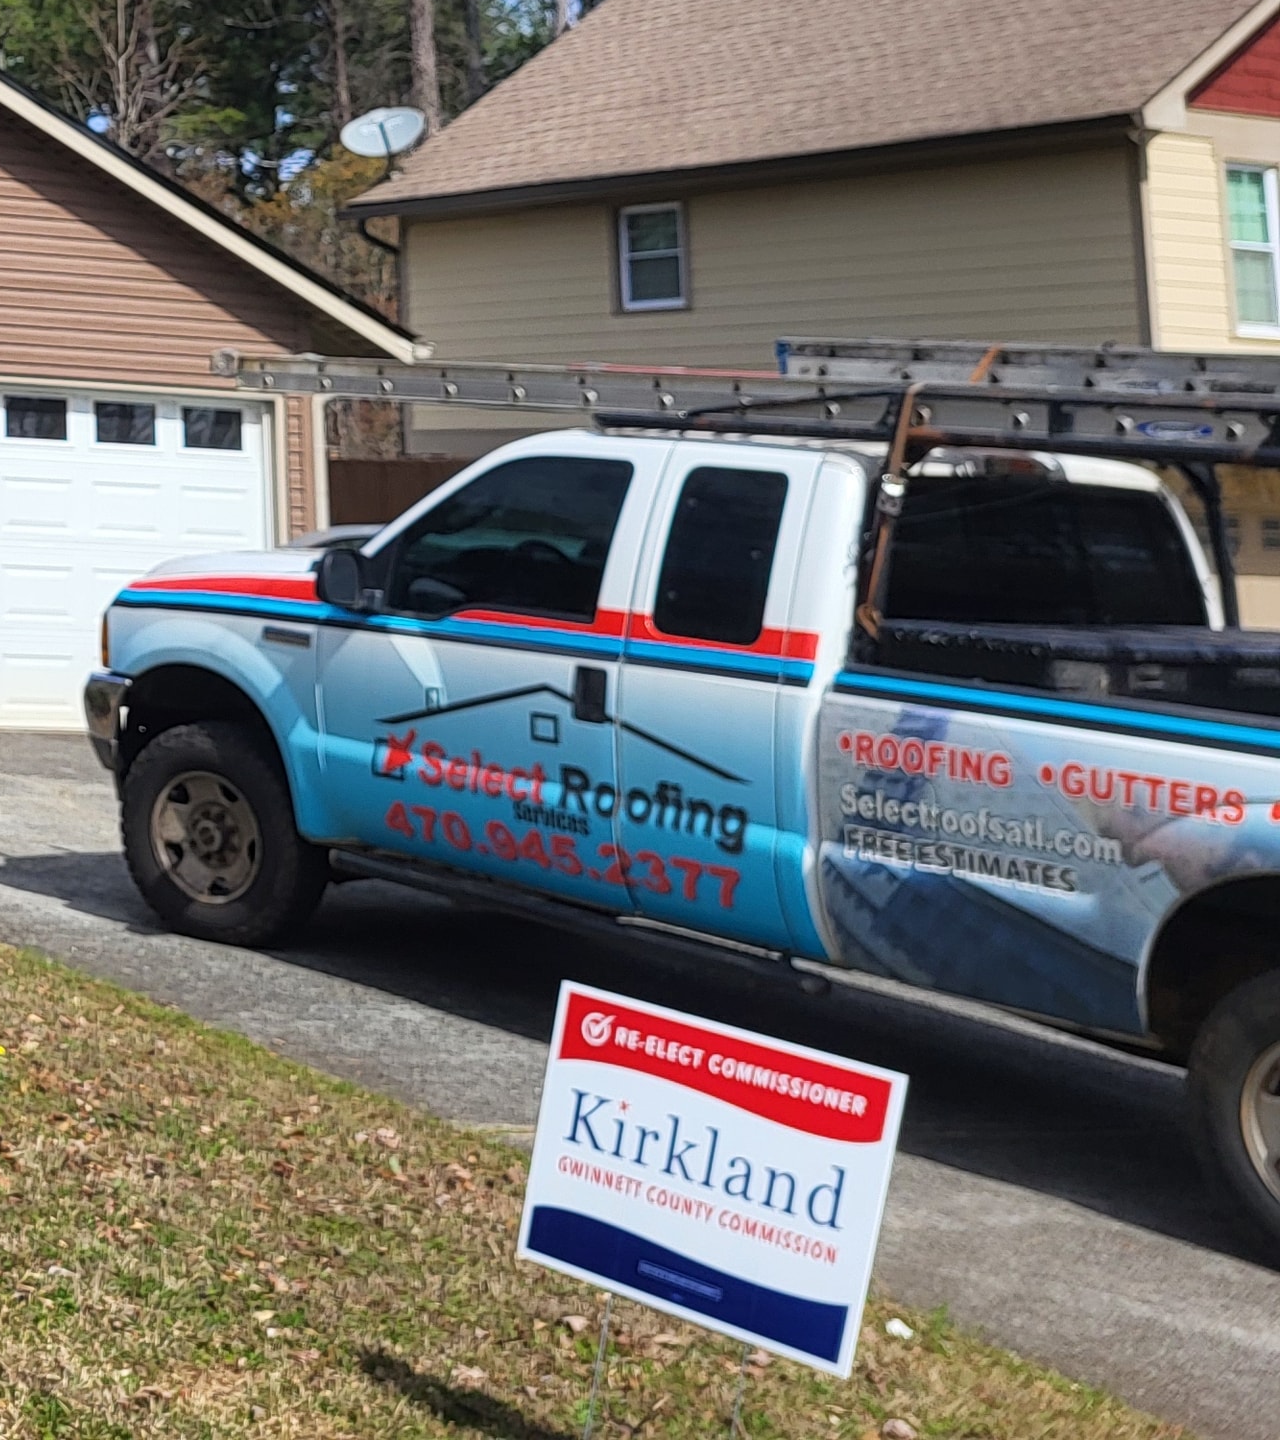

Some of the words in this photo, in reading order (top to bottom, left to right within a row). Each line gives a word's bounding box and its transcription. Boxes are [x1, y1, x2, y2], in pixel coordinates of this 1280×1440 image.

[418, 741, 545, 805] Select
[559, 766, 749, 855] Roofing
[854, 732, 1012, 788] ROOFING
[1062, 763, 1245, 824] GUTTERS
[385, 801, 740, 908] 470.945.2377
[844, 827, 914, 868] FREE
[916, 837, 1077, 895] ESTIMATES
[615, 1026, 705, 1068] RE-ELECT
[708, 1054, 868, 1118] COMMISSIONER
[557, 1155, 643, 1198] GWINNETT
[645, 1184, 714, 1222] COUNTY
[718, 1209, 838, 1266] COMMISSION
[563, 1088, 845, 1231] Kirkland
